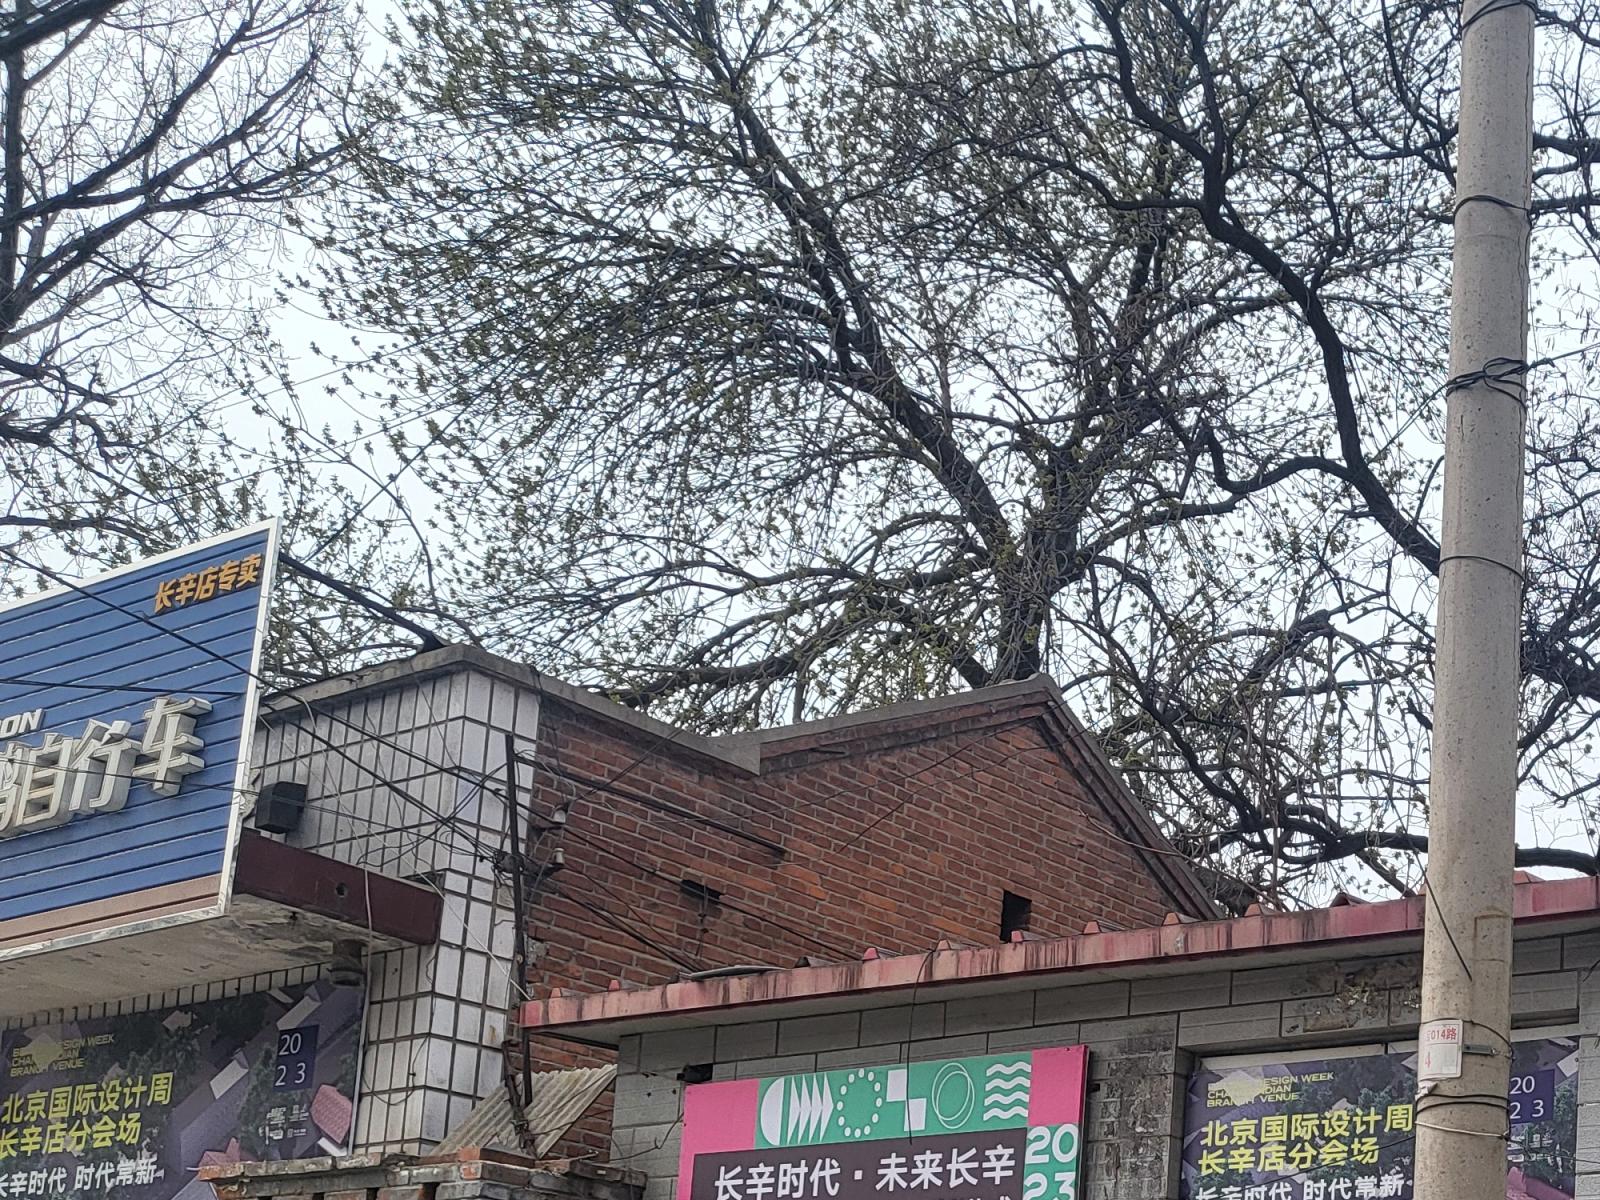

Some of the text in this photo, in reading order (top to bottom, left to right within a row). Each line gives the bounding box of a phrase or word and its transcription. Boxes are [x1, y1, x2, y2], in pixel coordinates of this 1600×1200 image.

[154, 553, 262, 615] 长辛店专卖
[0, 708, 44, 738] ON
[279, 1033, 301, 1056] 20
[1301, 1071, 1335, 1082] WEEK
[1510, 1075, 1536, 1095] 20
[2, 1072, 174, 1124] 北京国际设计周
[1259, 1092, 1300, 1102] VENUE
[0, 1112, 141, 1160] 长辛店分会场
[1026, 1123, 1079, 1164] 20
[1200, 1104, 1414, 1147] 北京国际设计周
[74, 1157, 158, 1191] 时代常新
[1198, 1136, 1379, 1176] 长辛店分会场
